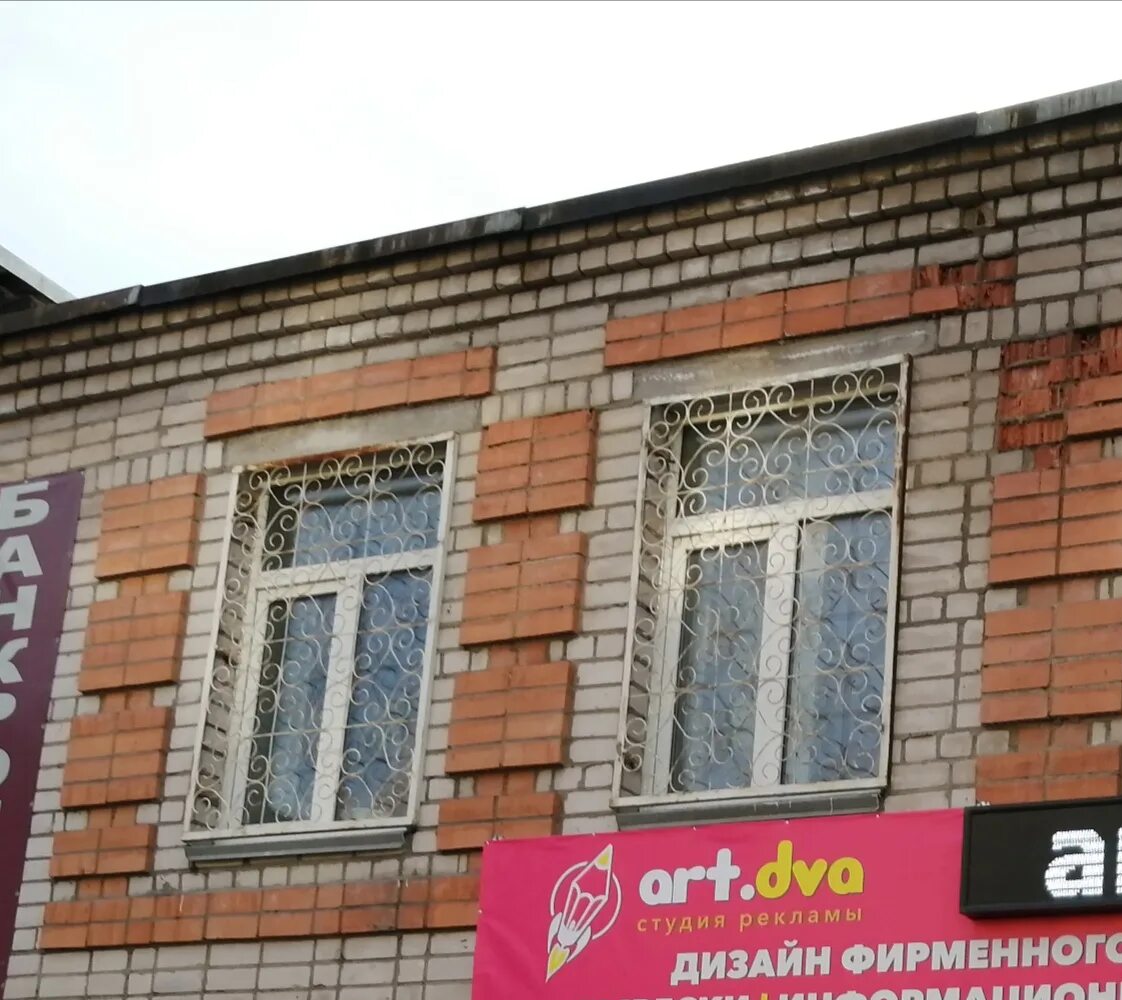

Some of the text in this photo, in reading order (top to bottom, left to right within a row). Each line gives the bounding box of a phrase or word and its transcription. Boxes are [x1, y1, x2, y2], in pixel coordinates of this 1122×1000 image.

[638, 840, 866, 906] art.dva
[637, 906, 864, 935] студия рекламы
[670, 940, 831, 986] ДИЗАЙН
